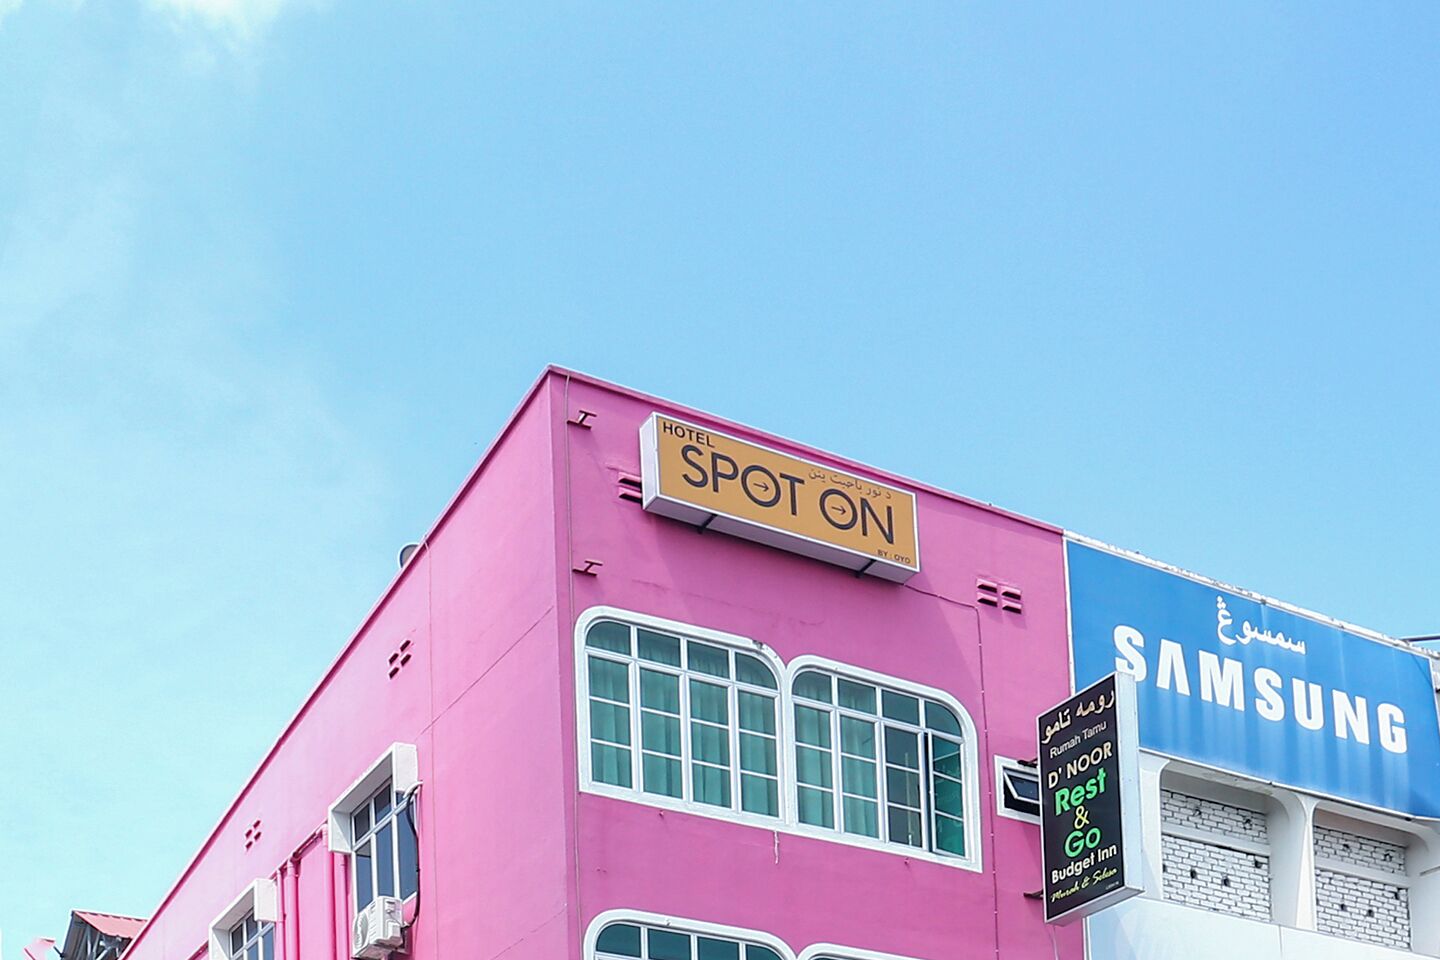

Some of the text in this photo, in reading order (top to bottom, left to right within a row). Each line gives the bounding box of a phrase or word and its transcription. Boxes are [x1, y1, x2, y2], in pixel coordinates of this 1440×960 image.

[662, 421, 715, 449] HOTEL
[681, 444, 895, 545] SPOT ON
[877, 549, 889, 559] BY
[894, 554, 912, 564] OYO
[1113, 624, 1408, 754] SAMSUNG
[1050, 721, 1107, 759] Rumah Tamu
[1066, 741, 1112, 779] NOOR
[1055, 768, 1107, 816] Rest
[1074, 805, 1090, 829] &
[1065, 827, 1101, 858] Go
[1052, 845, 1117, 884] Budget Inn
